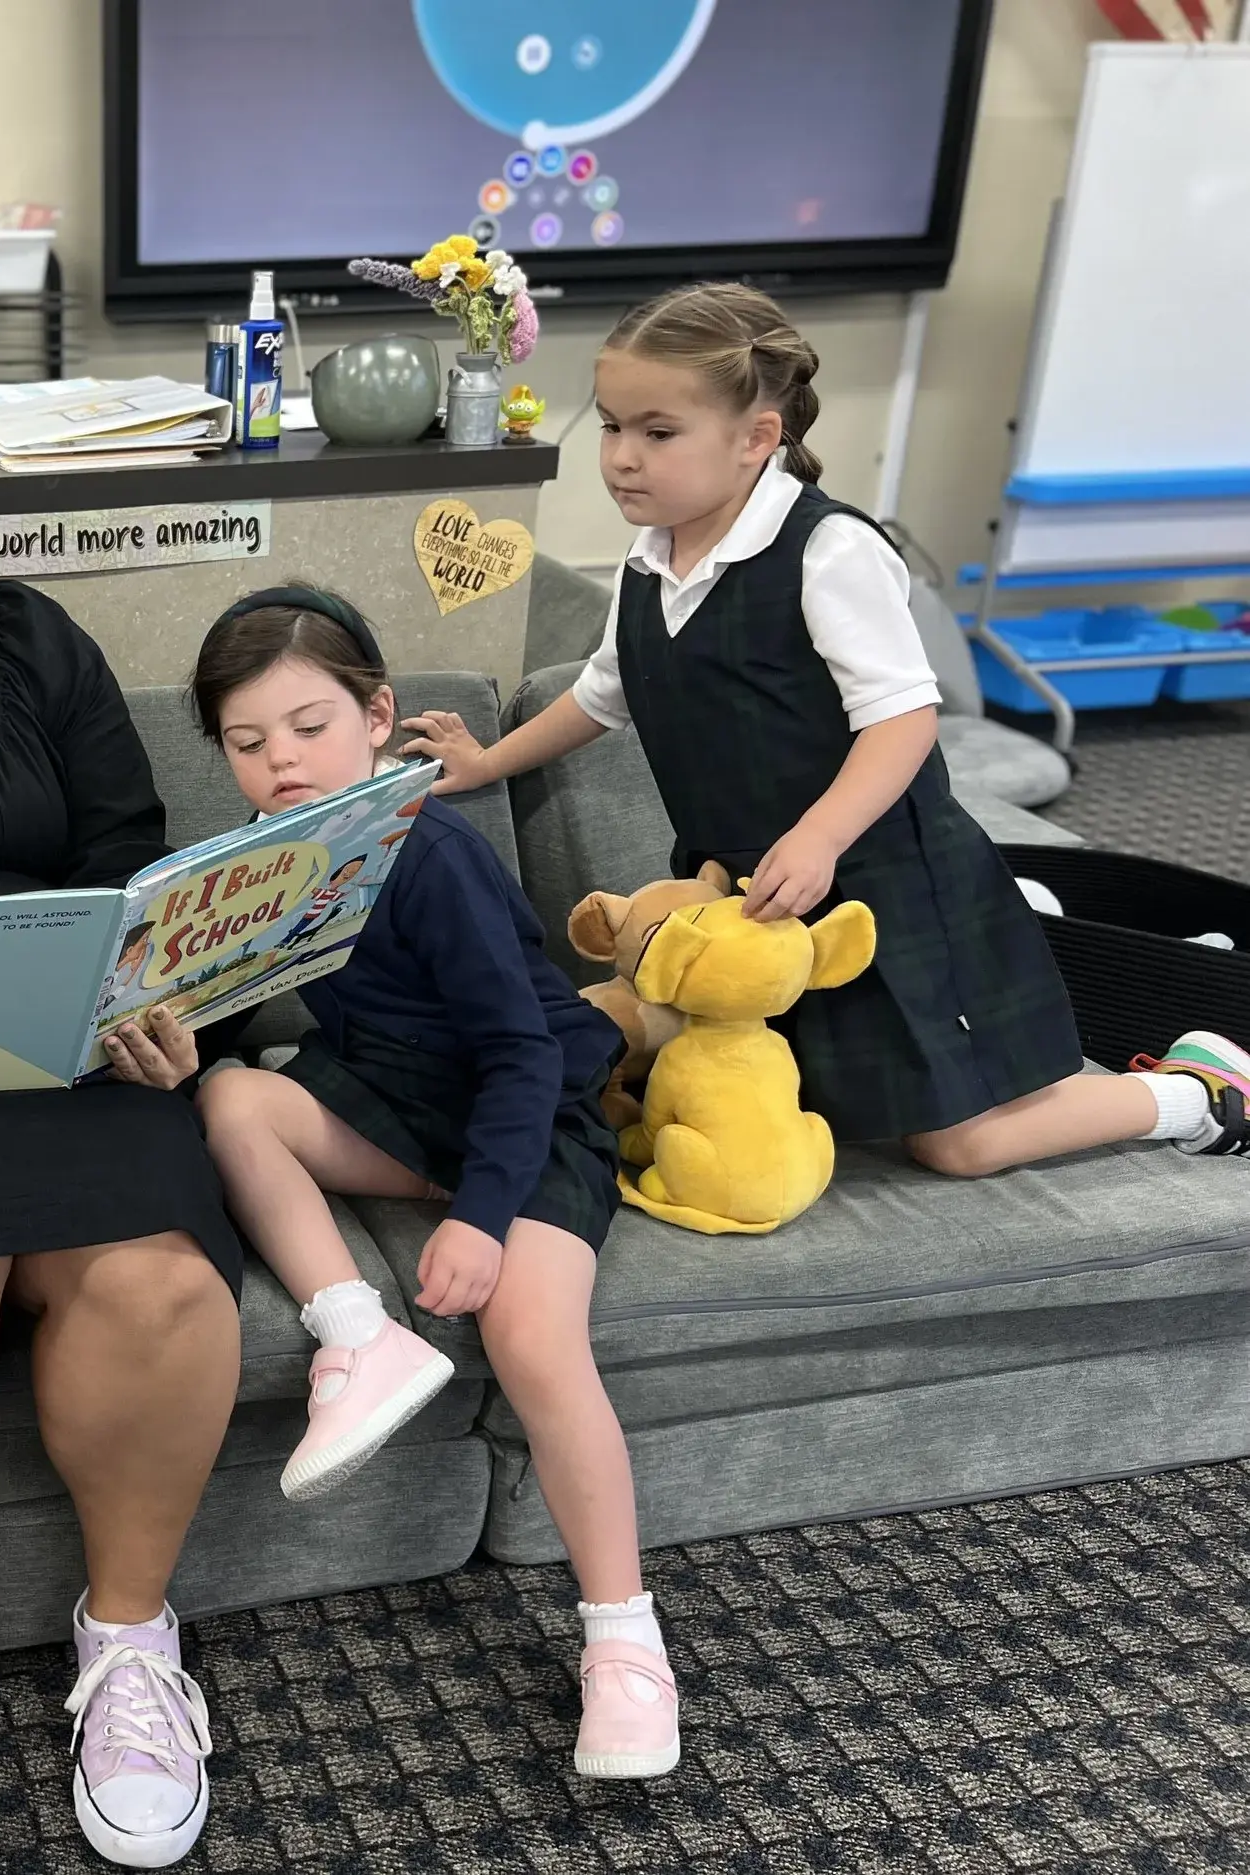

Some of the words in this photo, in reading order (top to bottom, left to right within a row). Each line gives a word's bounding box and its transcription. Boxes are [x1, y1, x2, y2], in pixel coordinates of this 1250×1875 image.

[76, 525, 145, 554] more
[156, 509, 261, 554] amazing
[431, 511, 475, 542] LOVE
[477, 532, 517, 560] CHANGES
[421, 532, 469, 562] EVERYTHING
[467, 550, 481, 566] SO
[480, 554, 498, 573] FILL
[497, 561, 514, 578] THE
[433, 556, 486, 592] WORLD
[438, 586, 456, 600] WITH
[455, 591, 466, 603] IT
[193, 868, 224, 914] I
[2, 923, 16, 931] TO
[19, 922, 32, 930] BE
[34, 920, 76, 929] FOUND!
[16, 912, 39, 920] WILL
[41, 910, 93, 919] ASTOUND.
[203, 907, 218, 922] a
